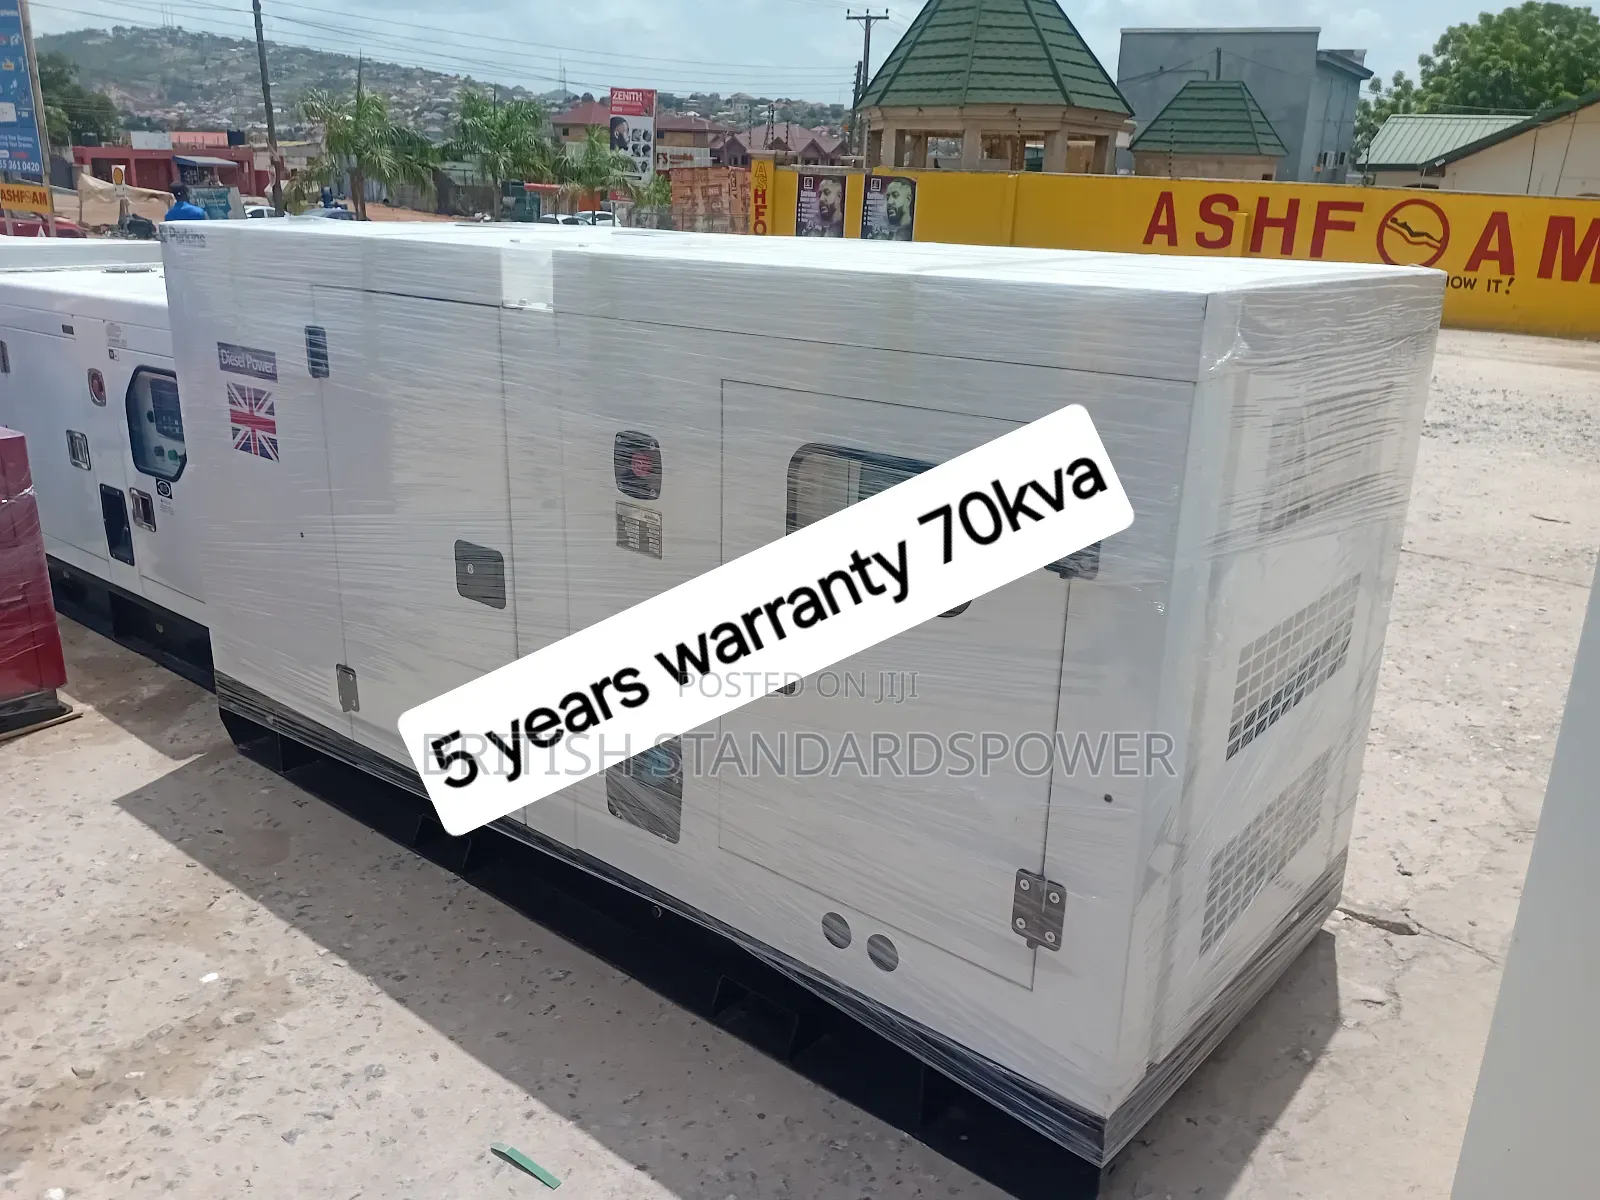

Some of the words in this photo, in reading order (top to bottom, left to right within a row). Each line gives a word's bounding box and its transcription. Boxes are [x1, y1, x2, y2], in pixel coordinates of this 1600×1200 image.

[612, 90, 643, 101] ZENITH
[8, 160, 21, 171] 361
[22, 161, 40, 172] 0420
[1, 188, 48, 206] ASHFOAM
[220, 349, 246, 369] Diesel
[246, 353, 274, 374] Power
